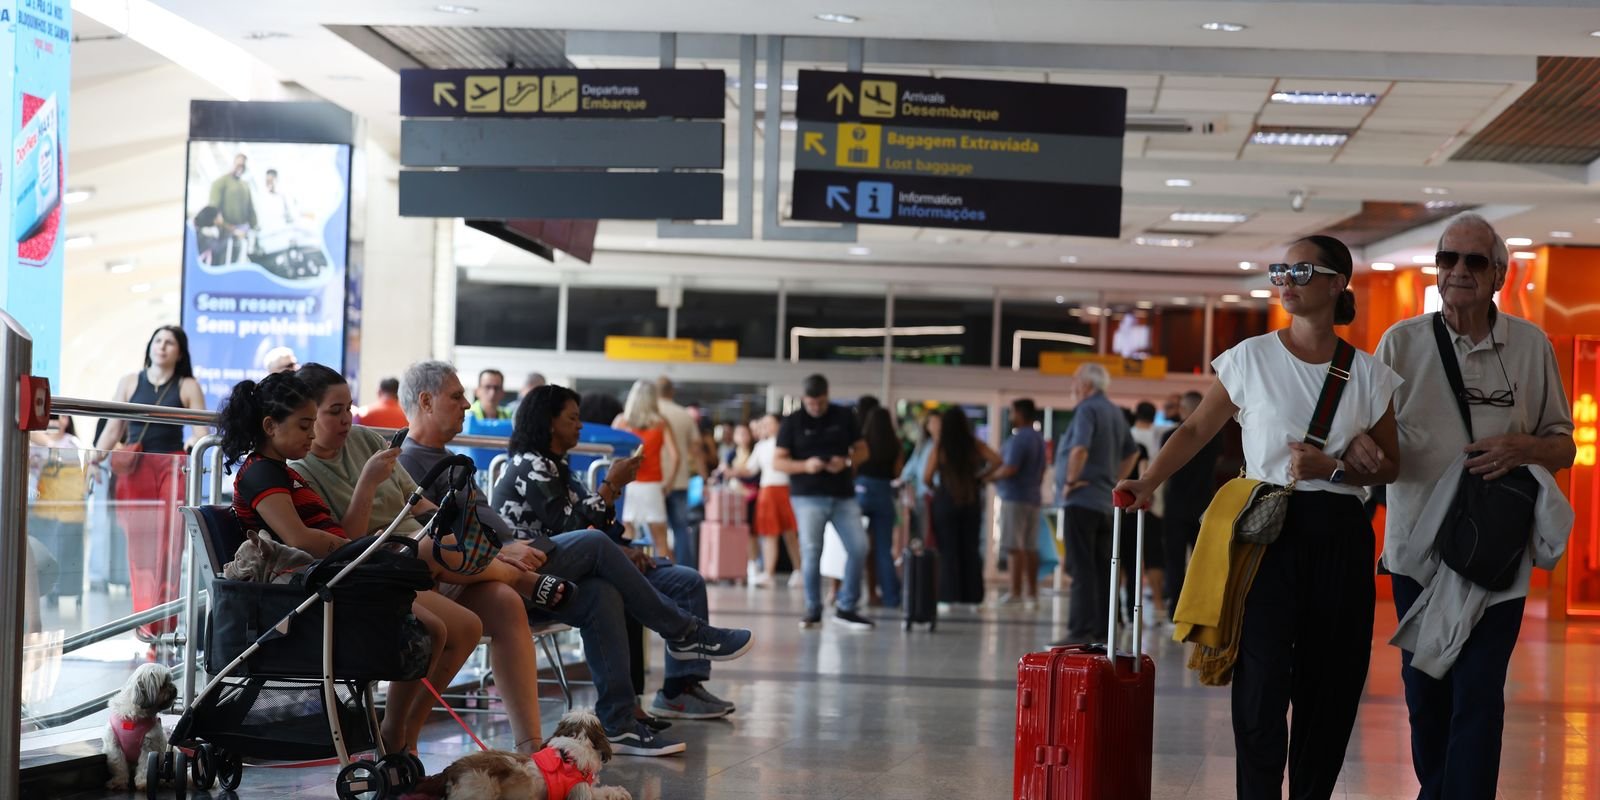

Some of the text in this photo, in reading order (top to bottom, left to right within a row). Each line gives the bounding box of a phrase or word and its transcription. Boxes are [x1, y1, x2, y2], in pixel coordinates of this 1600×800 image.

[582, 84, 639, 97] Departures
[902, 90, 945, 104] Arrivals
[582, 97, 647, 112] Embarque
[902, 102, 999, 122] Desembarque
[887, 131, 1039, 153] Bagagem Extraviada
[885, 157, 973, 175] Lost baggage
[899, 191, 963, 206] Information
[898, 203, 986, 222] Informações
[197, 293, 316, 314] Sem reserva?
[196, 315, 333, 338] Sem problema!
[536, 576, 556, 605] VANS
